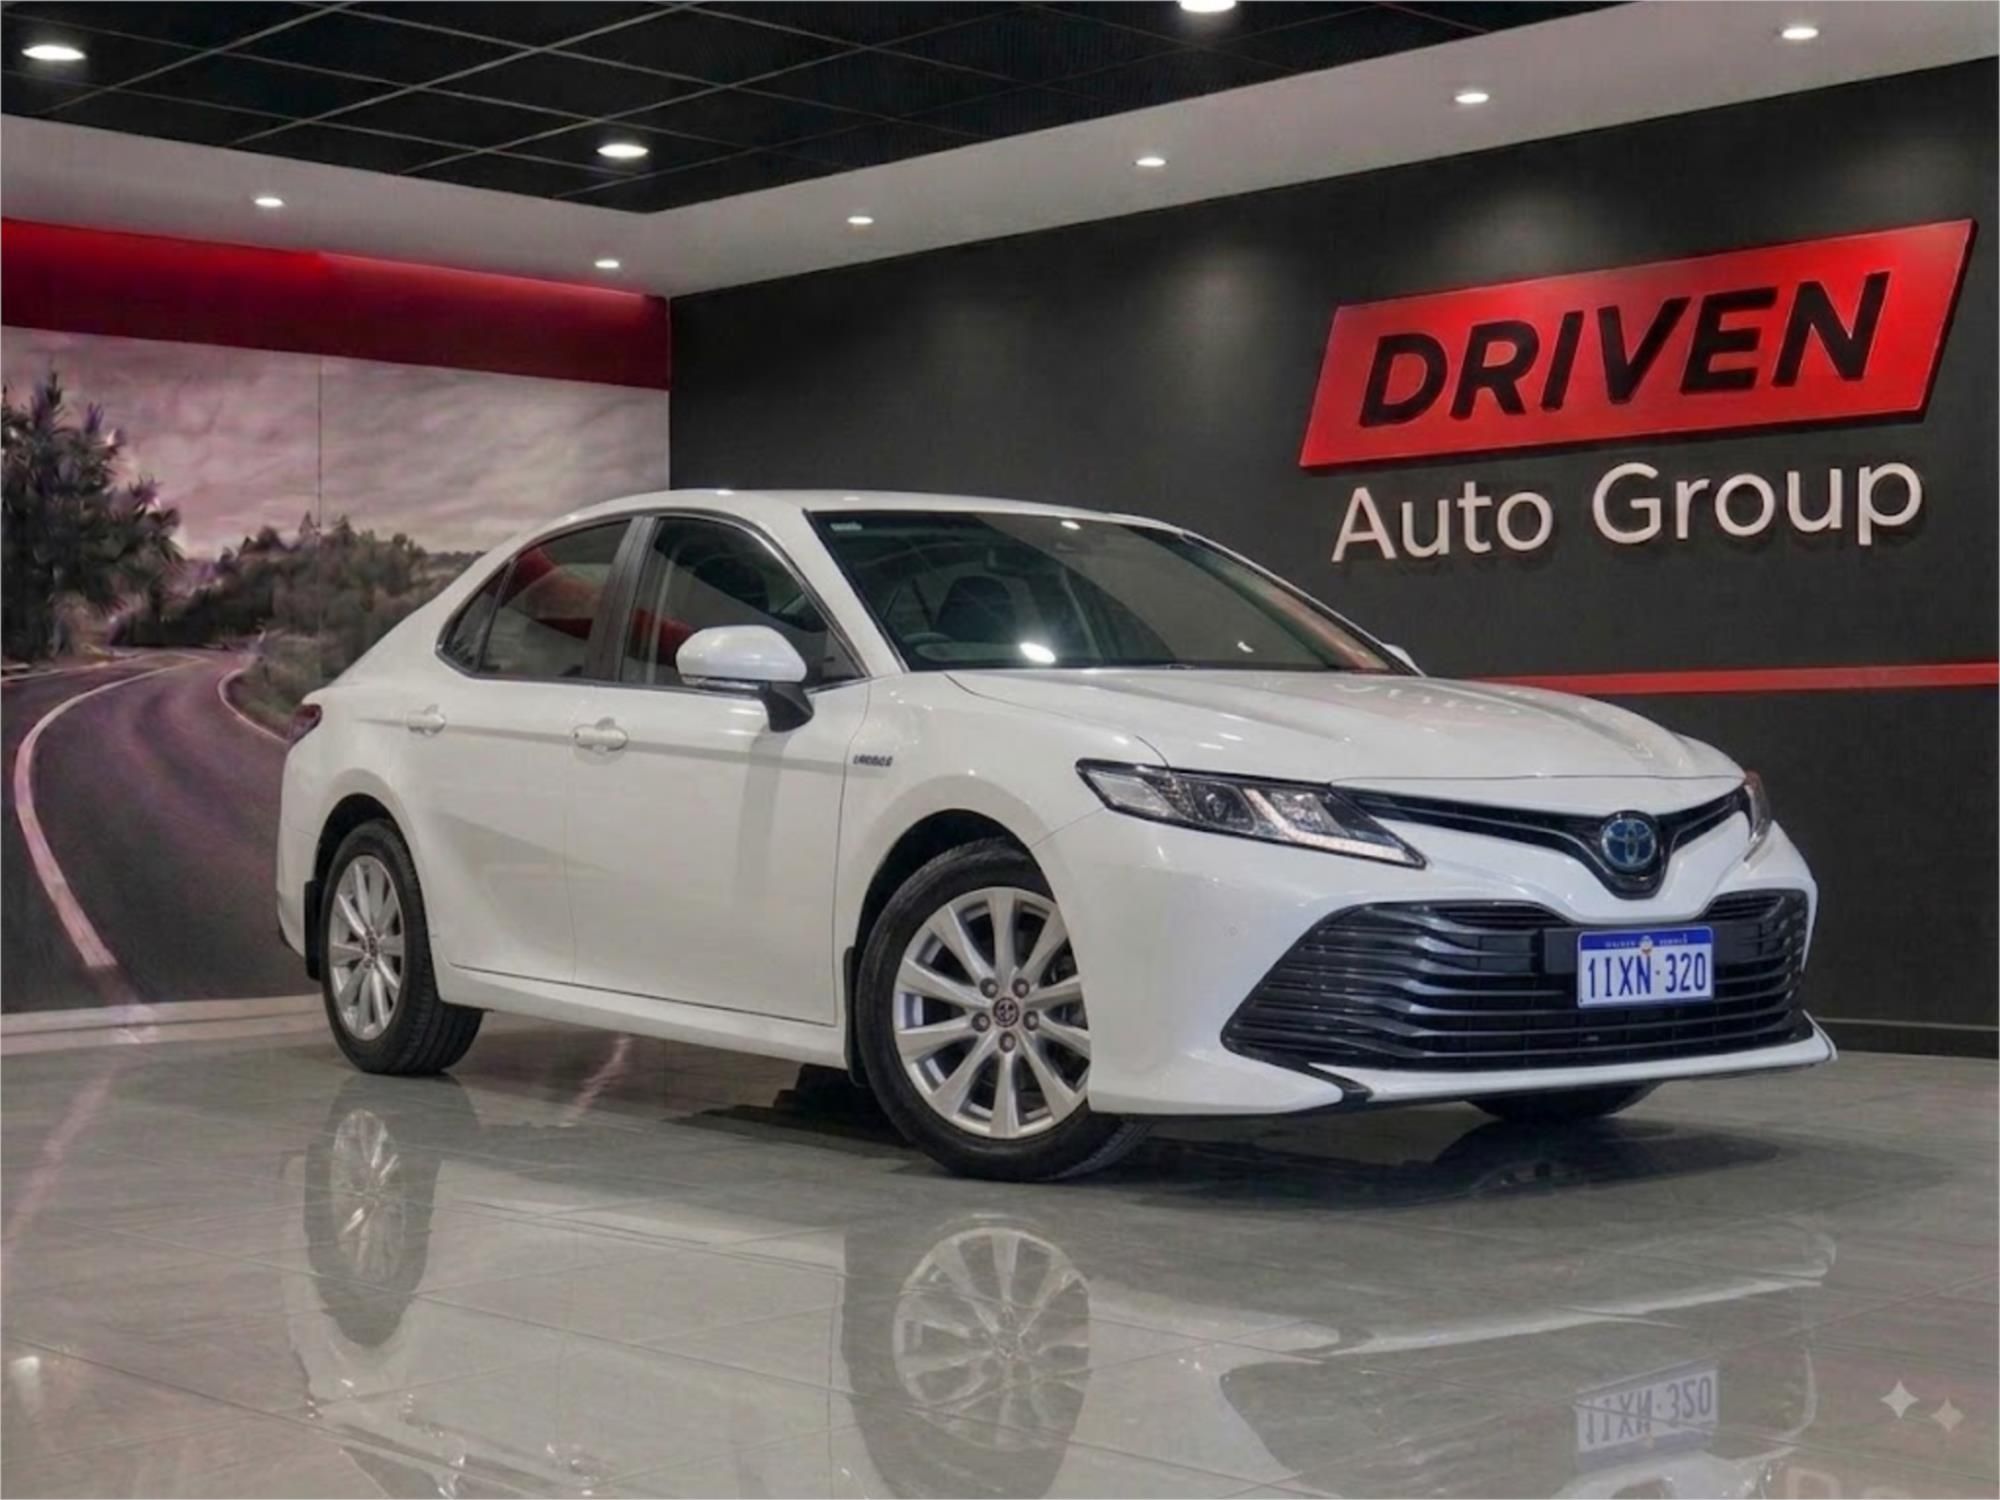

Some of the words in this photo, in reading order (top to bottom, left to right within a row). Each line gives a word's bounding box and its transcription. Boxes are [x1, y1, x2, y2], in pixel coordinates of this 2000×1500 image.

[1358, 271, 1890, 428] DRIVEN
[1331, 480, 1553, 562] Auto
[1592, 461, 1922, 545] Group
